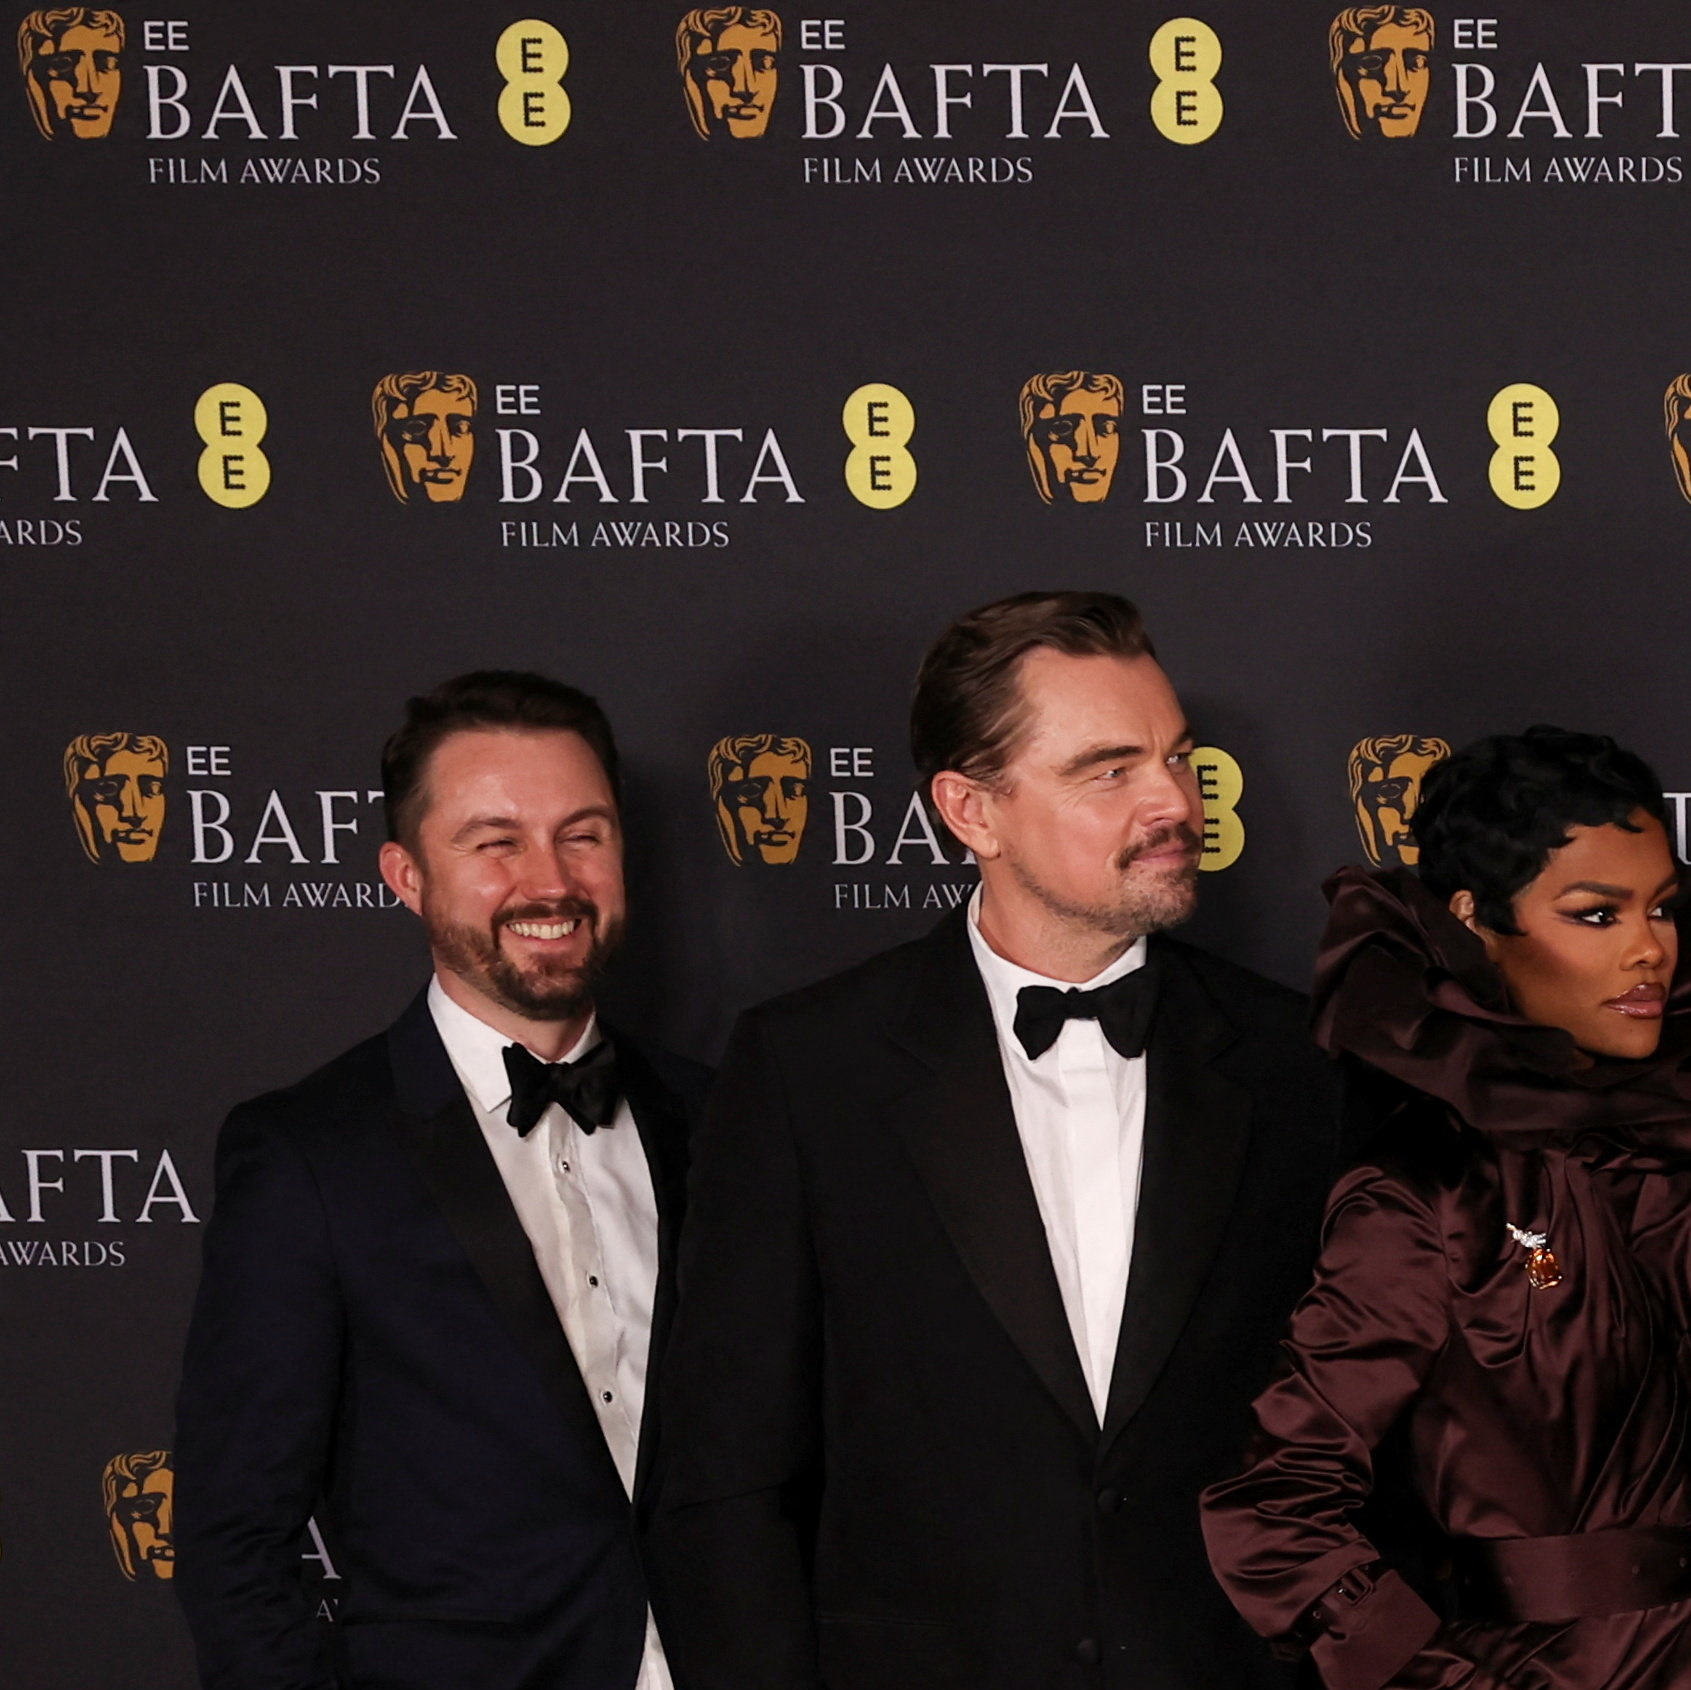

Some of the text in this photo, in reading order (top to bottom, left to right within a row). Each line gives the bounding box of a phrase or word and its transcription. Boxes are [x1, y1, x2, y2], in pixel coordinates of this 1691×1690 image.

[143, 20, 190, 51] EE
[800, 19, 846, 50] EE
[1453, 18, 1498, 49] EE
[142, 64, 458, 140] BAFTA
[799, 62, 1111, 139] BAFTA
[148, 157, 381, 184] FILM AWARDS
[803, 157, 1033, 184] FILM AWARDS
[1454, 156, 1683, 183] FILM AWARDS
[495, 384, 541, 415] EE
[1142, 384, 1187, 415] EE
[495, 427, 806, 504] BAFTA
[1140, 427, 1449, 504] BAFTA
[0, 519, 83, 546] ARDS
[501, 521, 730, 548] FILM AWARDS
[1145, 521, 1372, 548] FILM AWARDS
[186, 746, 232, 776] EE
[829, 747, 874, 777] EE
[186, 789, 386, 864] BAF
[192, 882, 404, 909] FILM AWARD
[833, 883, 910, 909] FILM
[0, 1148, 201, 1223] FTA
